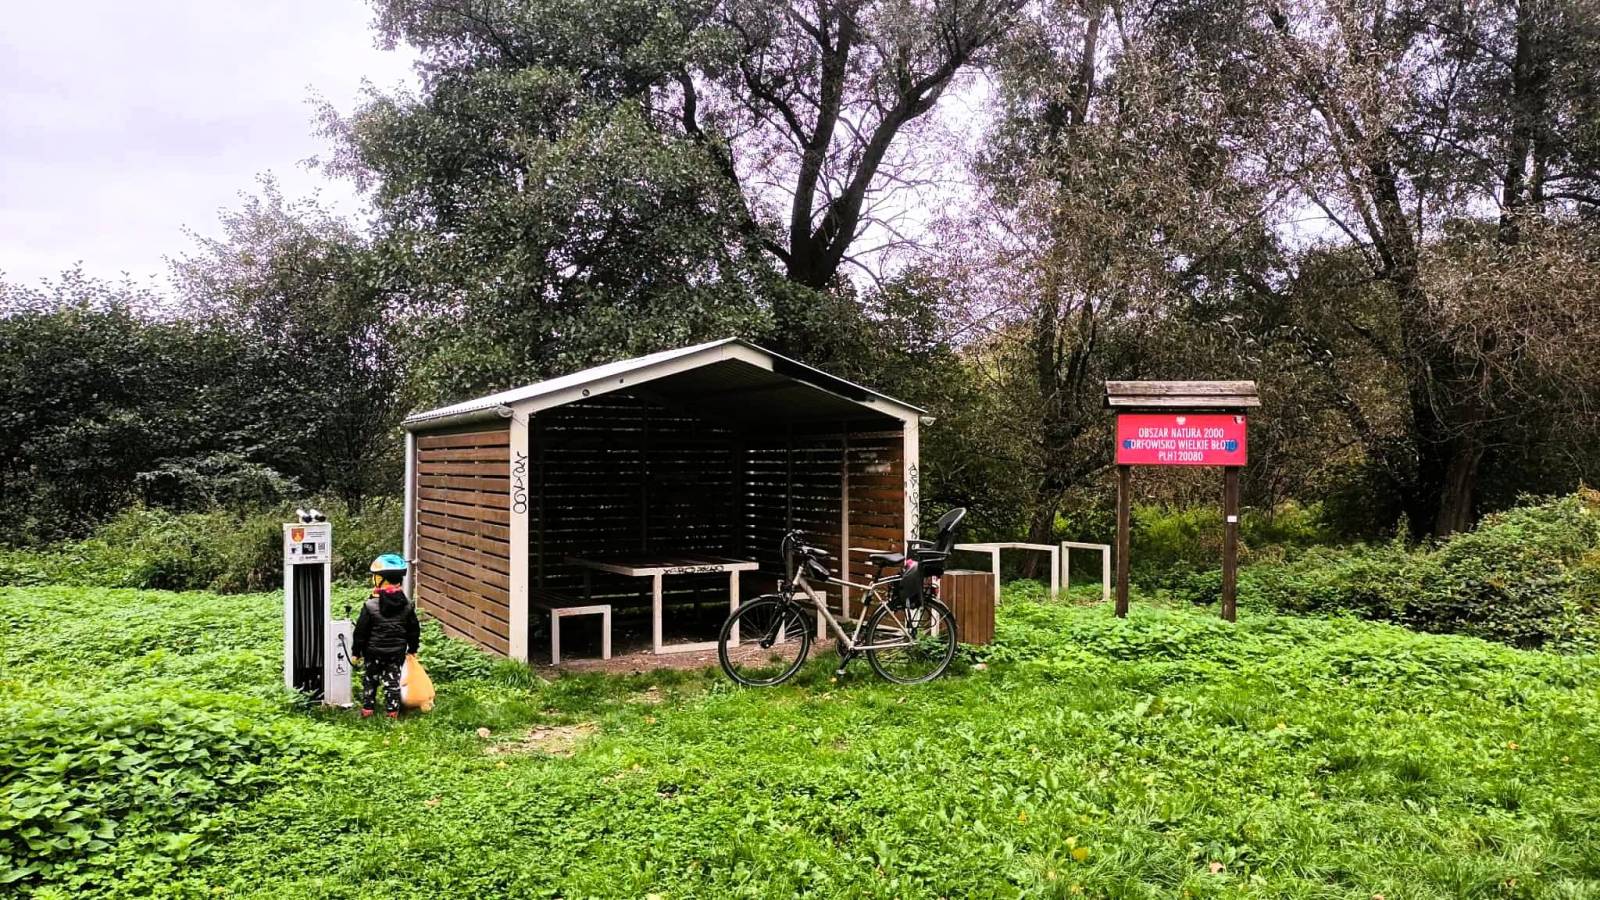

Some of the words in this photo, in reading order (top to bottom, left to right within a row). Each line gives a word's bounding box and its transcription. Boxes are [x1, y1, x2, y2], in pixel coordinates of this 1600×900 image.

[1138, 427, 1169, 438] OBSZAR
[1171, 427, 1202, 438] NATURA
[1203, 427, 1224, 438] 2000
[1178, 439, 1209, 450] WIELKIE
[1211, 439, 1236, 451] BŁOTO
[1158, 451, 1204, 461] PLH120080
